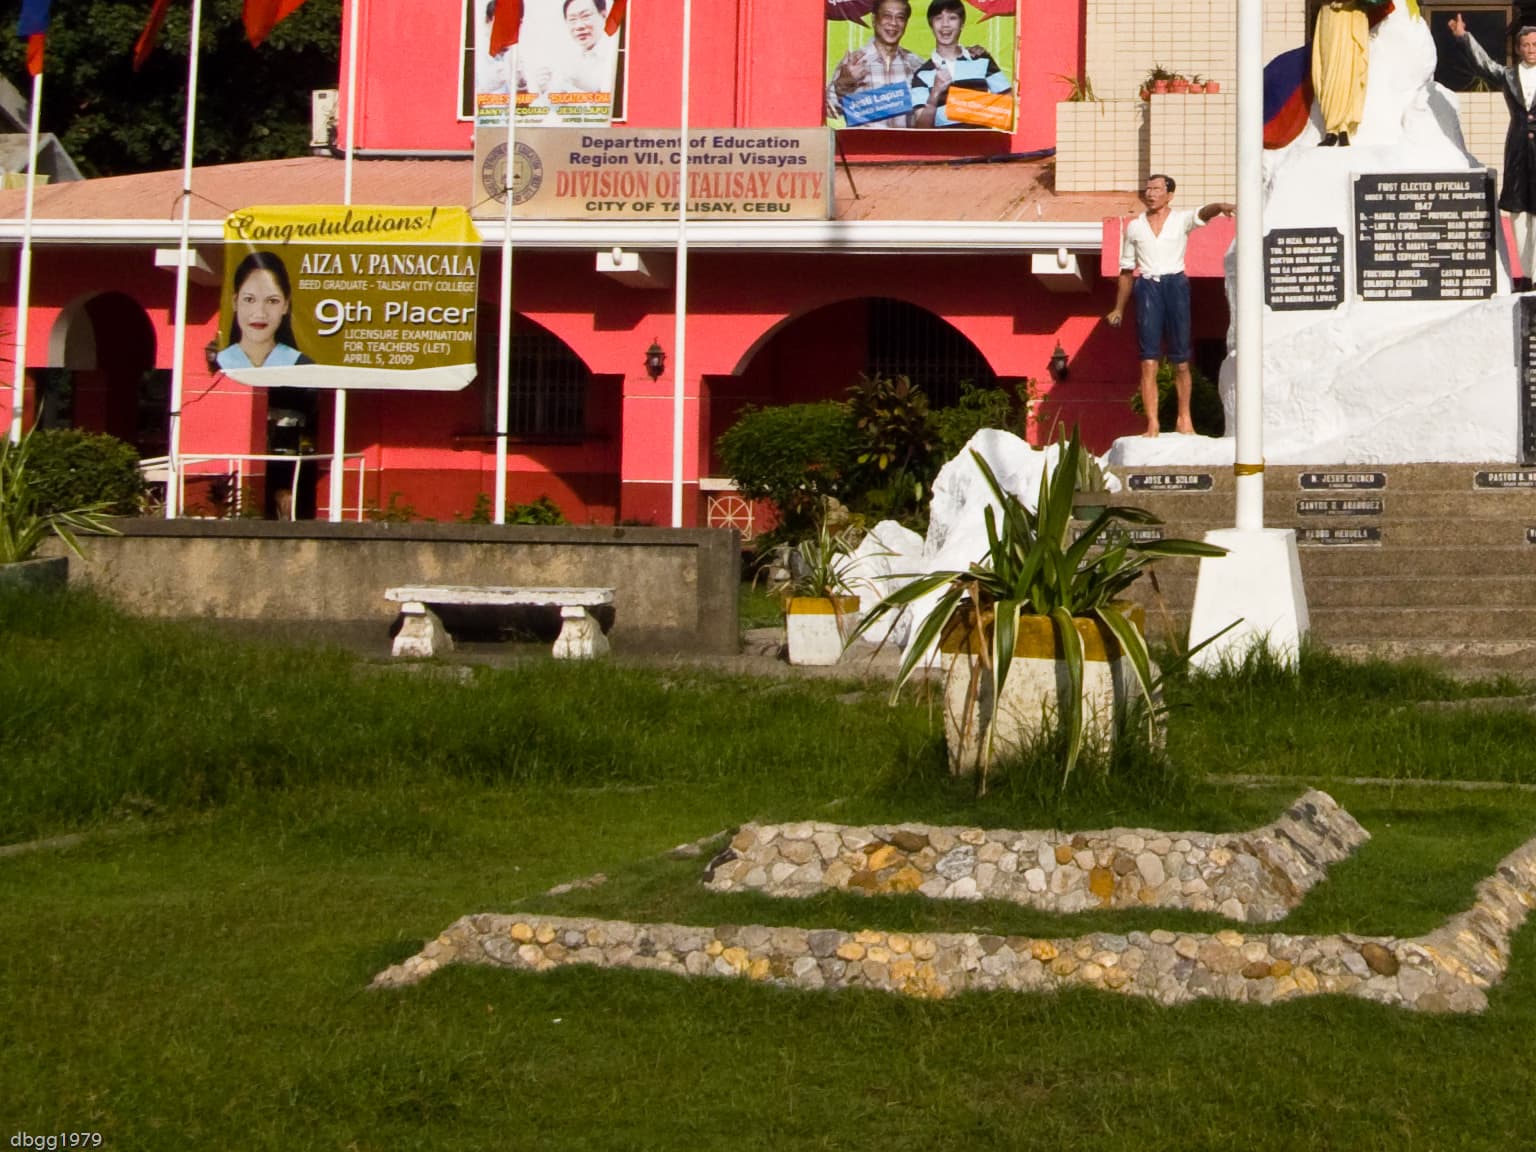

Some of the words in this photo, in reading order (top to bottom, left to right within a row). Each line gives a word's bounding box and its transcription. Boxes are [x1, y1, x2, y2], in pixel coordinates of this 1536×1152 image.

[582, 136, 682, 150] Department
[689, 135, 708, 149] of
[713, 135, 800, 149] Education
[569, 152, 628, 168] Region
[739, 152, 808, 168] Visayas
[556, 170, 651, 199] DIVISION
[686, 171, 771, 200] TALISAY
[775, 170, 824, 200] CITY
[1378, 182, 1398, 191] FIRST
[1400, 182, 1432, 191] ELECTED
[1434, 181, 1471, 191] OFFICIALS
[585, 201, 627, 213] CITY
[632, 201, 655, 213] OF
[661, 201, 737, 215] TALISAY,
[743, 202, 791, 214] CEBU
[228, 206, 438, 245] Congratulations!
[300, 253, 344, 275] AIZA
[350, 253, 364, 275] V.
[367, 253, 475, 276] PANSACALA
[323, 280, 369, 291] GRADUATE
[376, 280, 411, 291] TALISAY
[413, 281, 434, 291] CITY
[435, 281, 475, 292] COLLEGE
[314, 298, 373, 336] 9th
[384, 301, 475, 324] Placer
[344, 330, 399, 340] LICENSURE
[401, 330, 473, 341] EXAMINATION
[343, 342, 365, 352] FOR
[367, 342, 421, 353] TEACHERS
[422, 342, 451, 355] (LET)
[343, 353, 372, 364] APRIL
[375, 353, 385, 366] 5,
[388, 354, 414, 364] 2009
